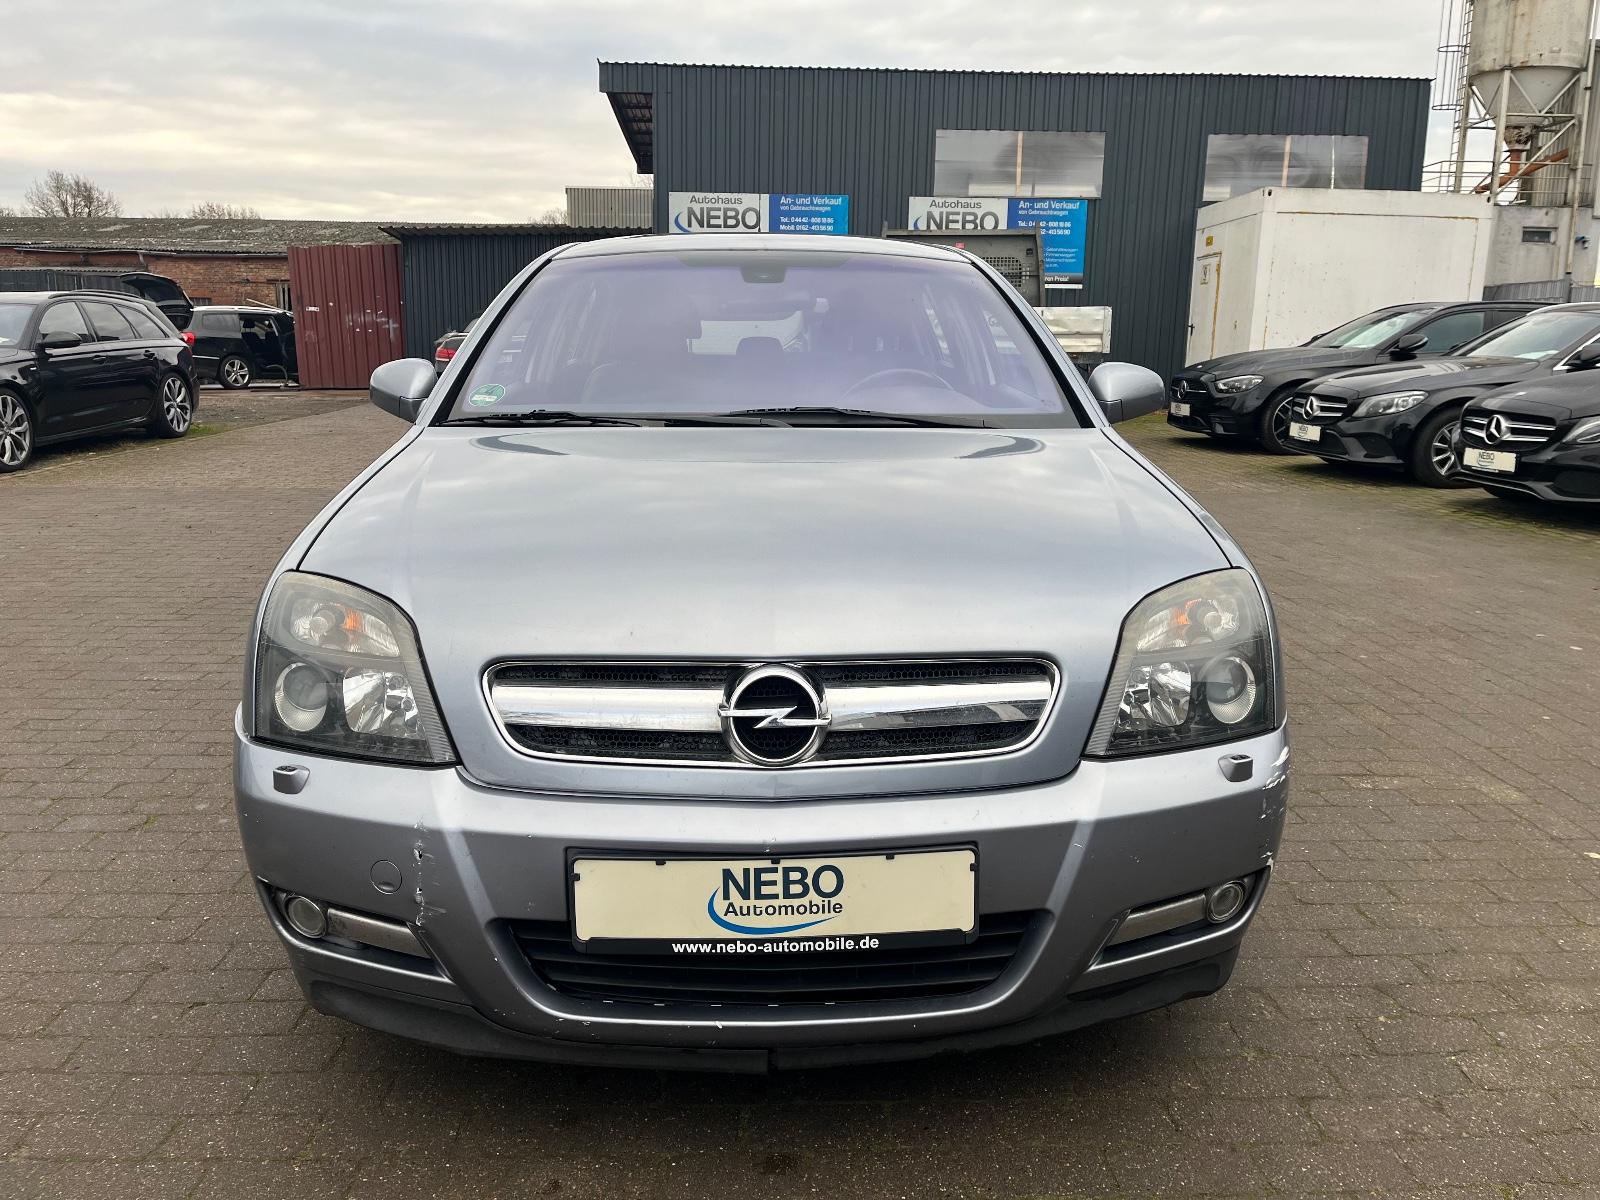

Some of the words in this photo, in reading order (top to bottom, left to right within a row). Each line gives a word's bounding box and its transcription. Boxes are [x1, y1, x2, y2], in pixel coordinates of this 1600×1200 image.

[690, 195, 743, 205] Autohaus
[780, 196, 794, 204] An-
[813, 197, 842, 205] Verkauf
[930, 200, 982, 209] Autohaus
[1019, 200, 1032, 208] An-
[1035, 201, 1049, 209] und
[1051, 201, 1080, 209] Verkauf
[687, 207, 760, 229] NEBO
[926, 211, 999, 230] NEBO
[722, 865, 844, 900] NEBO
[723, 900, 843, 917] Automobile
[671, 936, 880, 954] www.nebo-automobile.de
